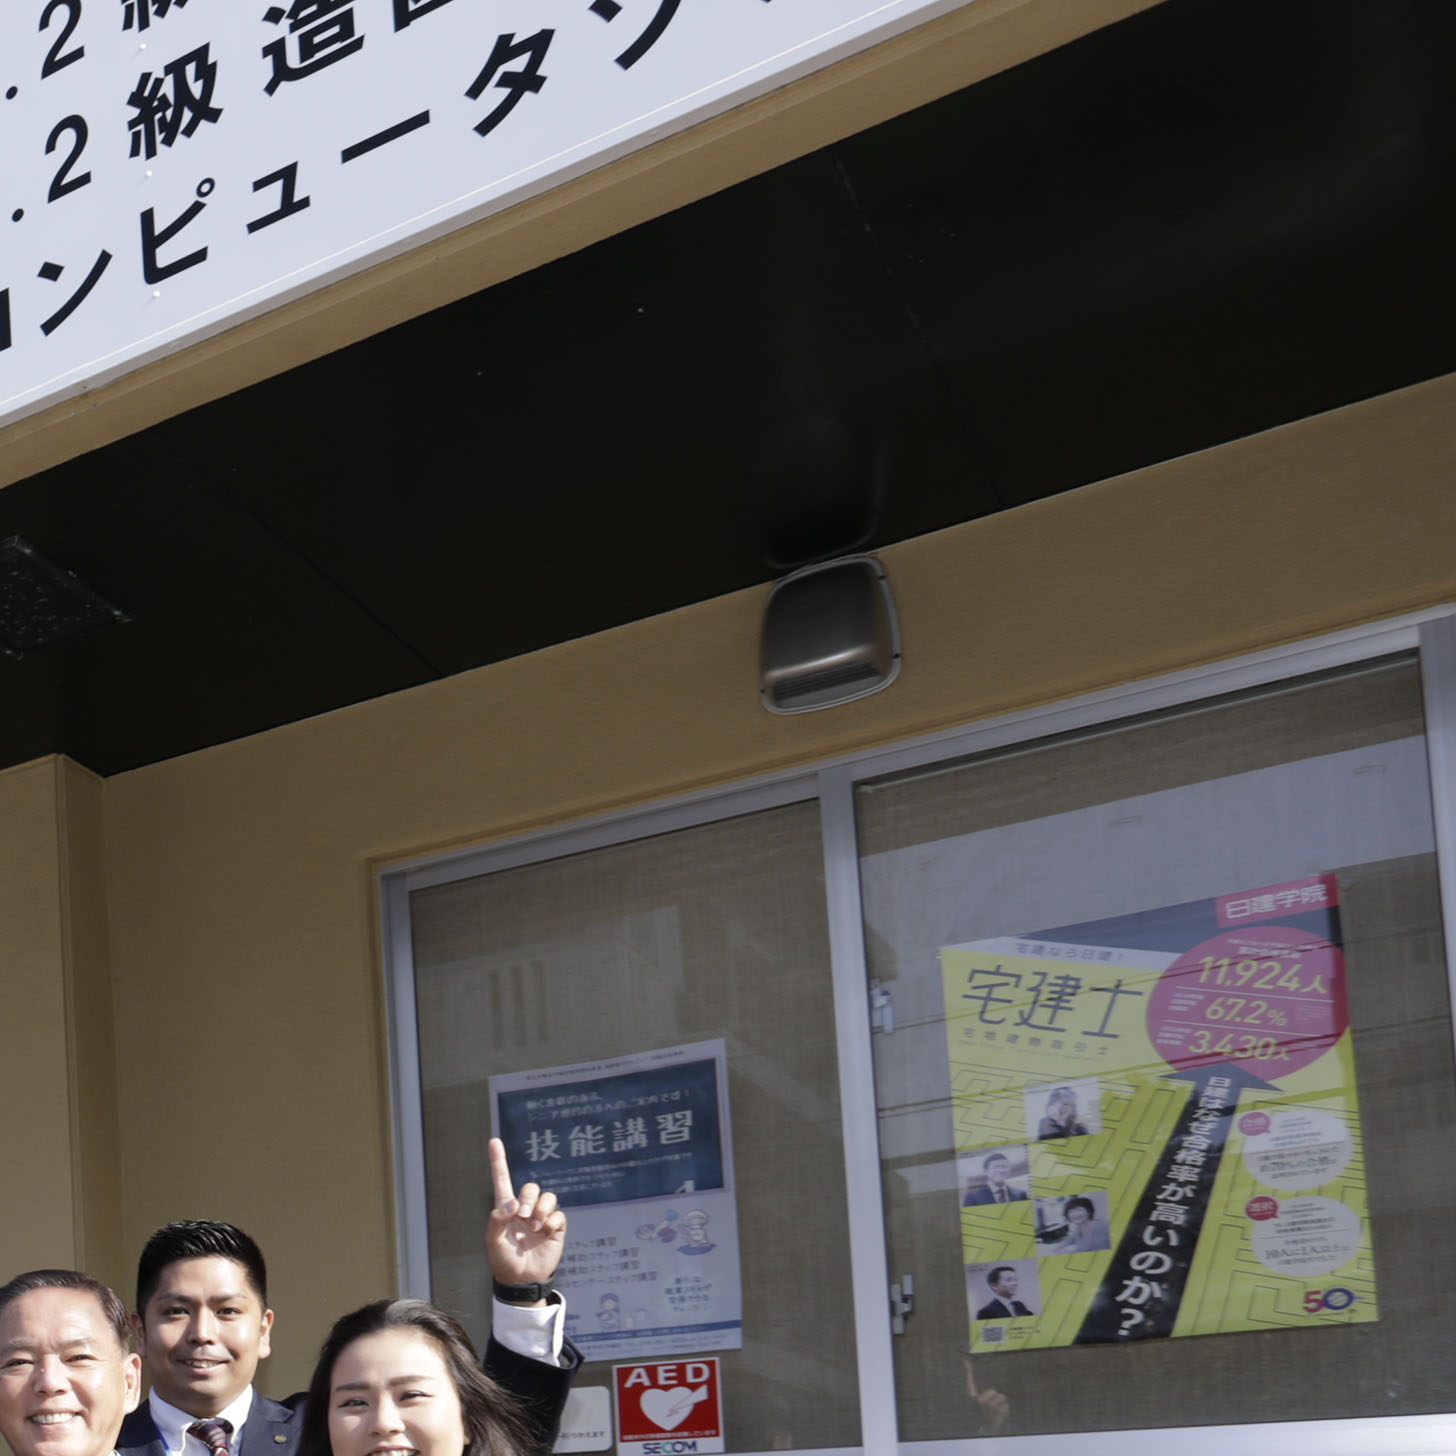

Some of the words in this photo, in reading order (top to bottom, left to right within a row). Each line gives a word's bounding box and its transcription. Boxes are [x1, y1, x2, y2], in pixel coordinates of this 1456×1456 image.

[1226, 884, 1328, 919] 日建学院
[962, 964, 1144, 1038] 宅建士
[525, 1110, 693, 1162] 技能講習
[624, 1363, 710, 1388] AED
[642, 1441, 697, 1455] SECOM
